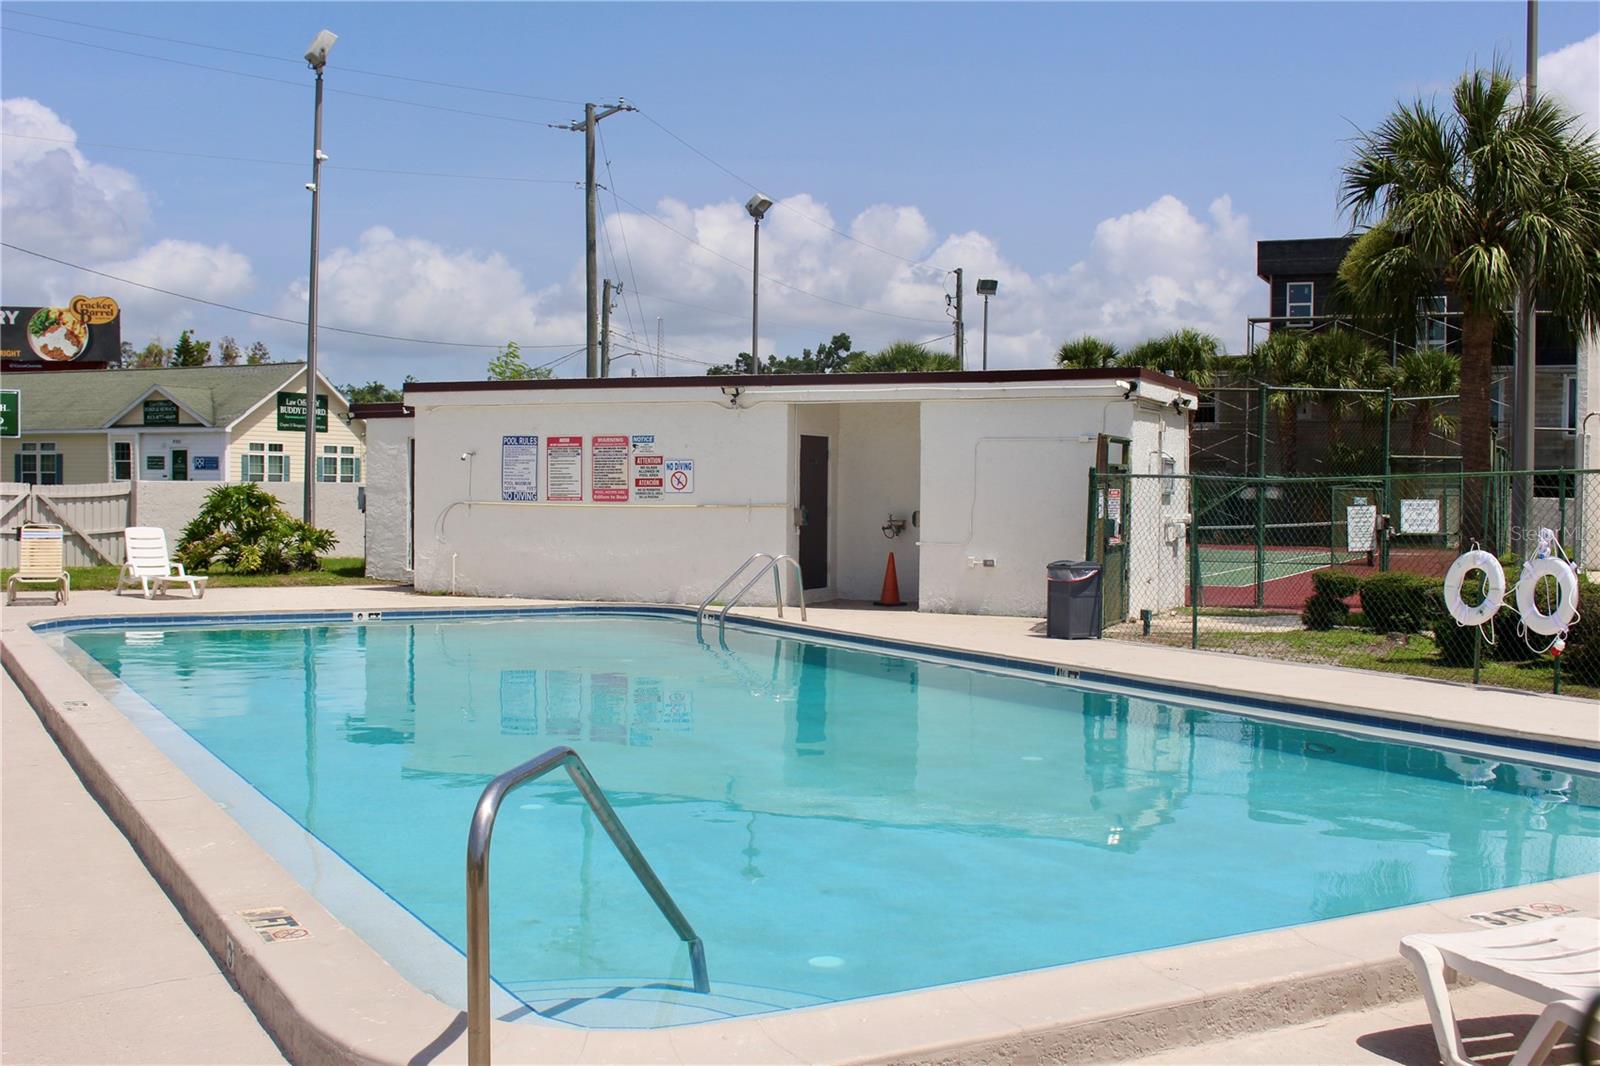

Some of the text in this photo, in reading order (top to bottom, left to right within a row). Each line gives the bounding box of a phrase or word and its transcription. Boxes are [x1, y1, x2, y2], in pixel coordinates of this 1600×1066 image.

[73, 298, 113, 314] Cracker
[81, 309, 114, 322] Barrel
[286, 398, 296, 406] Law
[280, 405, 301, 415] BUDDY
[503, 436, 537, 446] POOL RULES
[666, 462, 692, 471] NO DIVING
[503, 491, 537, 501] NO DIVING
[1492, 907, 1545, 922] FT
